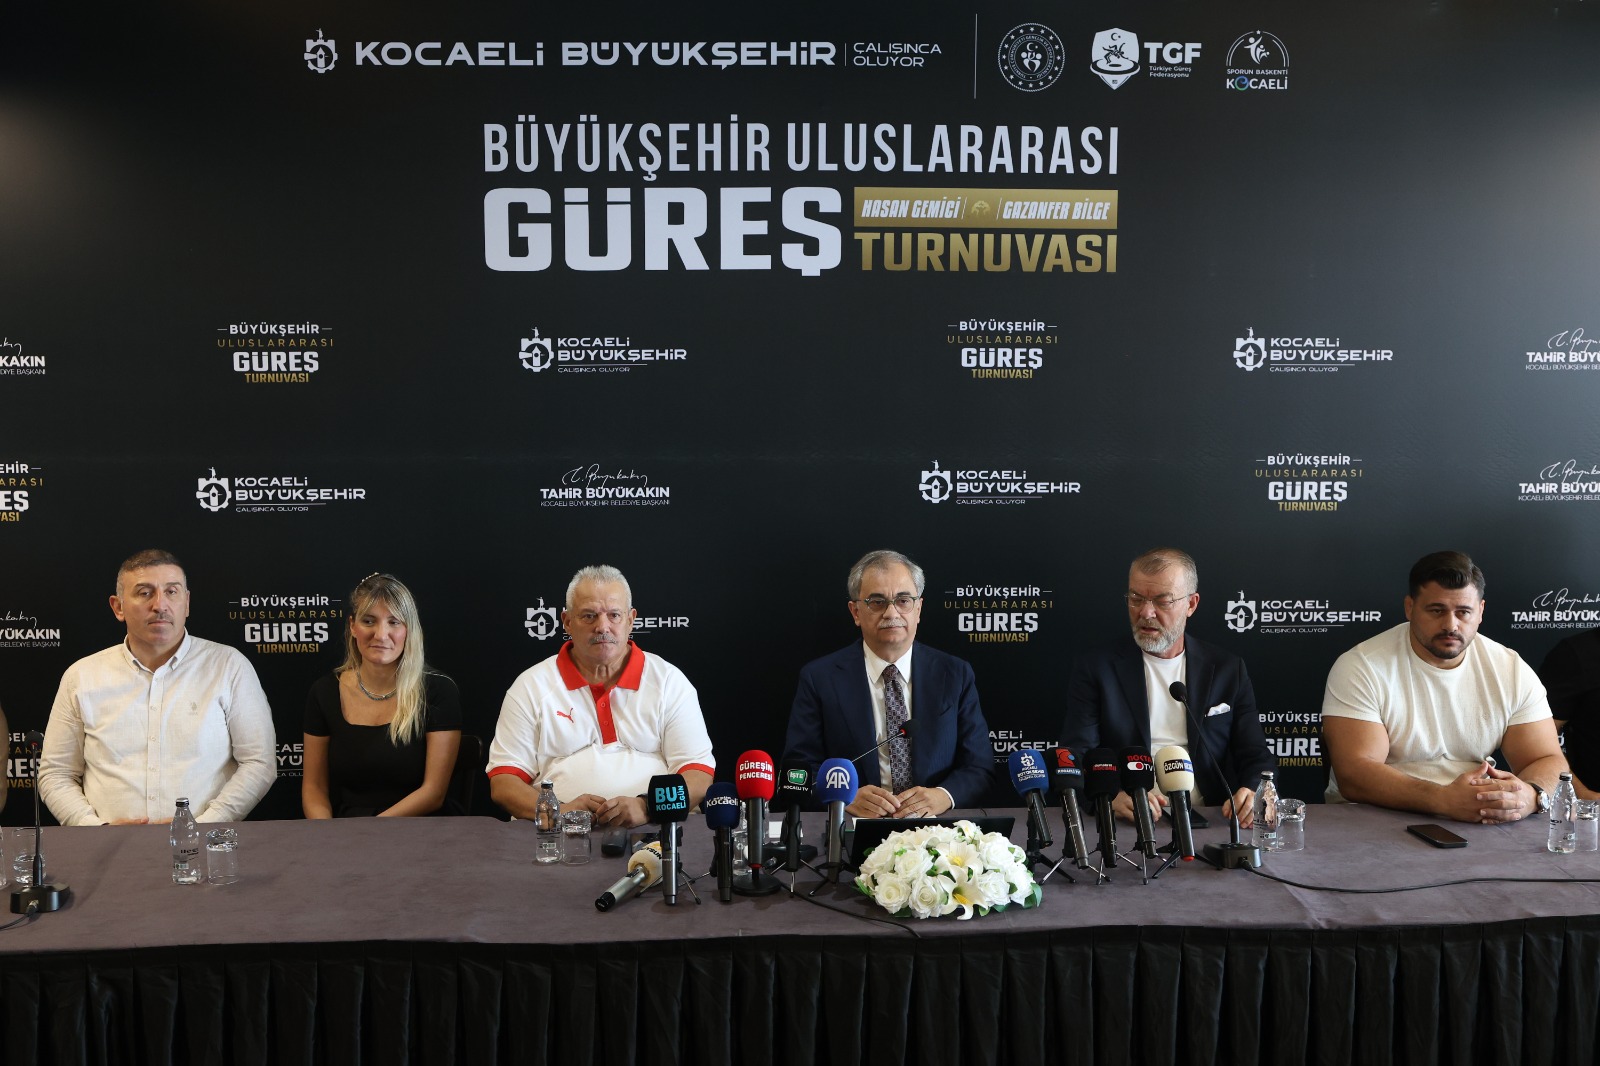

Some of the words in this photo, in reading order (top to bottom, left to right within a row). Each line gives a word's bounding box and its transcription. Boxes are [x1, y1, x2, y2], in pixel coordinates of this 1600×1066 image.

[853, 43, 942, 55] ÇALIŞINCA
[1144, 42, 1202, 64] TGF
[853, 56, 924, 67] OLUYOR
[483, 114, 770, 181] BÜYÜKŞEHİR
[786, 122, 1119, 174] ULUSLARARASI
[861, 200, 910, 217] HASAN
[911, 196, 961, 218] GEMİCİ
[1003, 201, 1069, 220] GAZANFER
[1072, 198, 1110, 220] BİLGE
[484, 187, 842, 277] GÜREŞ
[854, 232, 1117, 272] TURNUVASI
[230, 321, 320, 337] BÜYÜKŞEHİR
[959, 319, 1045, 333] BÜYÜKŞEHİR
[217, 338, 333, 347] ULUSLARARASI
[947, 335, 1058, 344] ULUSLARARASI
[0, 356, 45, 367] KAKIN
[233, 351, 319, 373] GÜREŞ
[961, 348, 1043, 369] GÜREŞ
[245, 373, 309, 383] TURNUVASI
[972, 369, 1033, 379] TURNUVASI
[1267, 453, 1350, 467] BÜYÜKŞEHİR
[1255, 469, 1362, 477] ULUSLARARASI
[586, 486, 670, 498] BÜYÜKAKIN
[1268, 481, 1348, 502] GÜREŞ
[1278, 502, 1338, 512] TURNUVASI
[956, 585, 1040, 599] BÜYÜKŞEHİR
[241, 594, 329, 608] BÜYÜKŞEHİR
[944, 600, 1052, 609] ULUSLARARASI
[230, 610, 342, 620] ULUSLARARASI
[1554, 610, 1600, 621] BÜYÜK
[958, 612, 1038, 632] GÜREŞ
[244, 622, 328, 643] GÜREŞ
[968, 633, 1028, 642] TURNUVASI
[256, 643, 319, 654] TURNUVASI
[1259, 711, 1322, 724] BÜYÜKŞE
[740, 761, 773, 772] GÜREŞİN
[1144, 763, 1153, 772] TV
[740, 771, 773, 781] PENCERESİ
[826, 772, 850, 789] AA
[655, 787, 677, 803] BU
[677, 785, 686, 800] GÜN
[706, 797, 738, 808] Kocaeli
